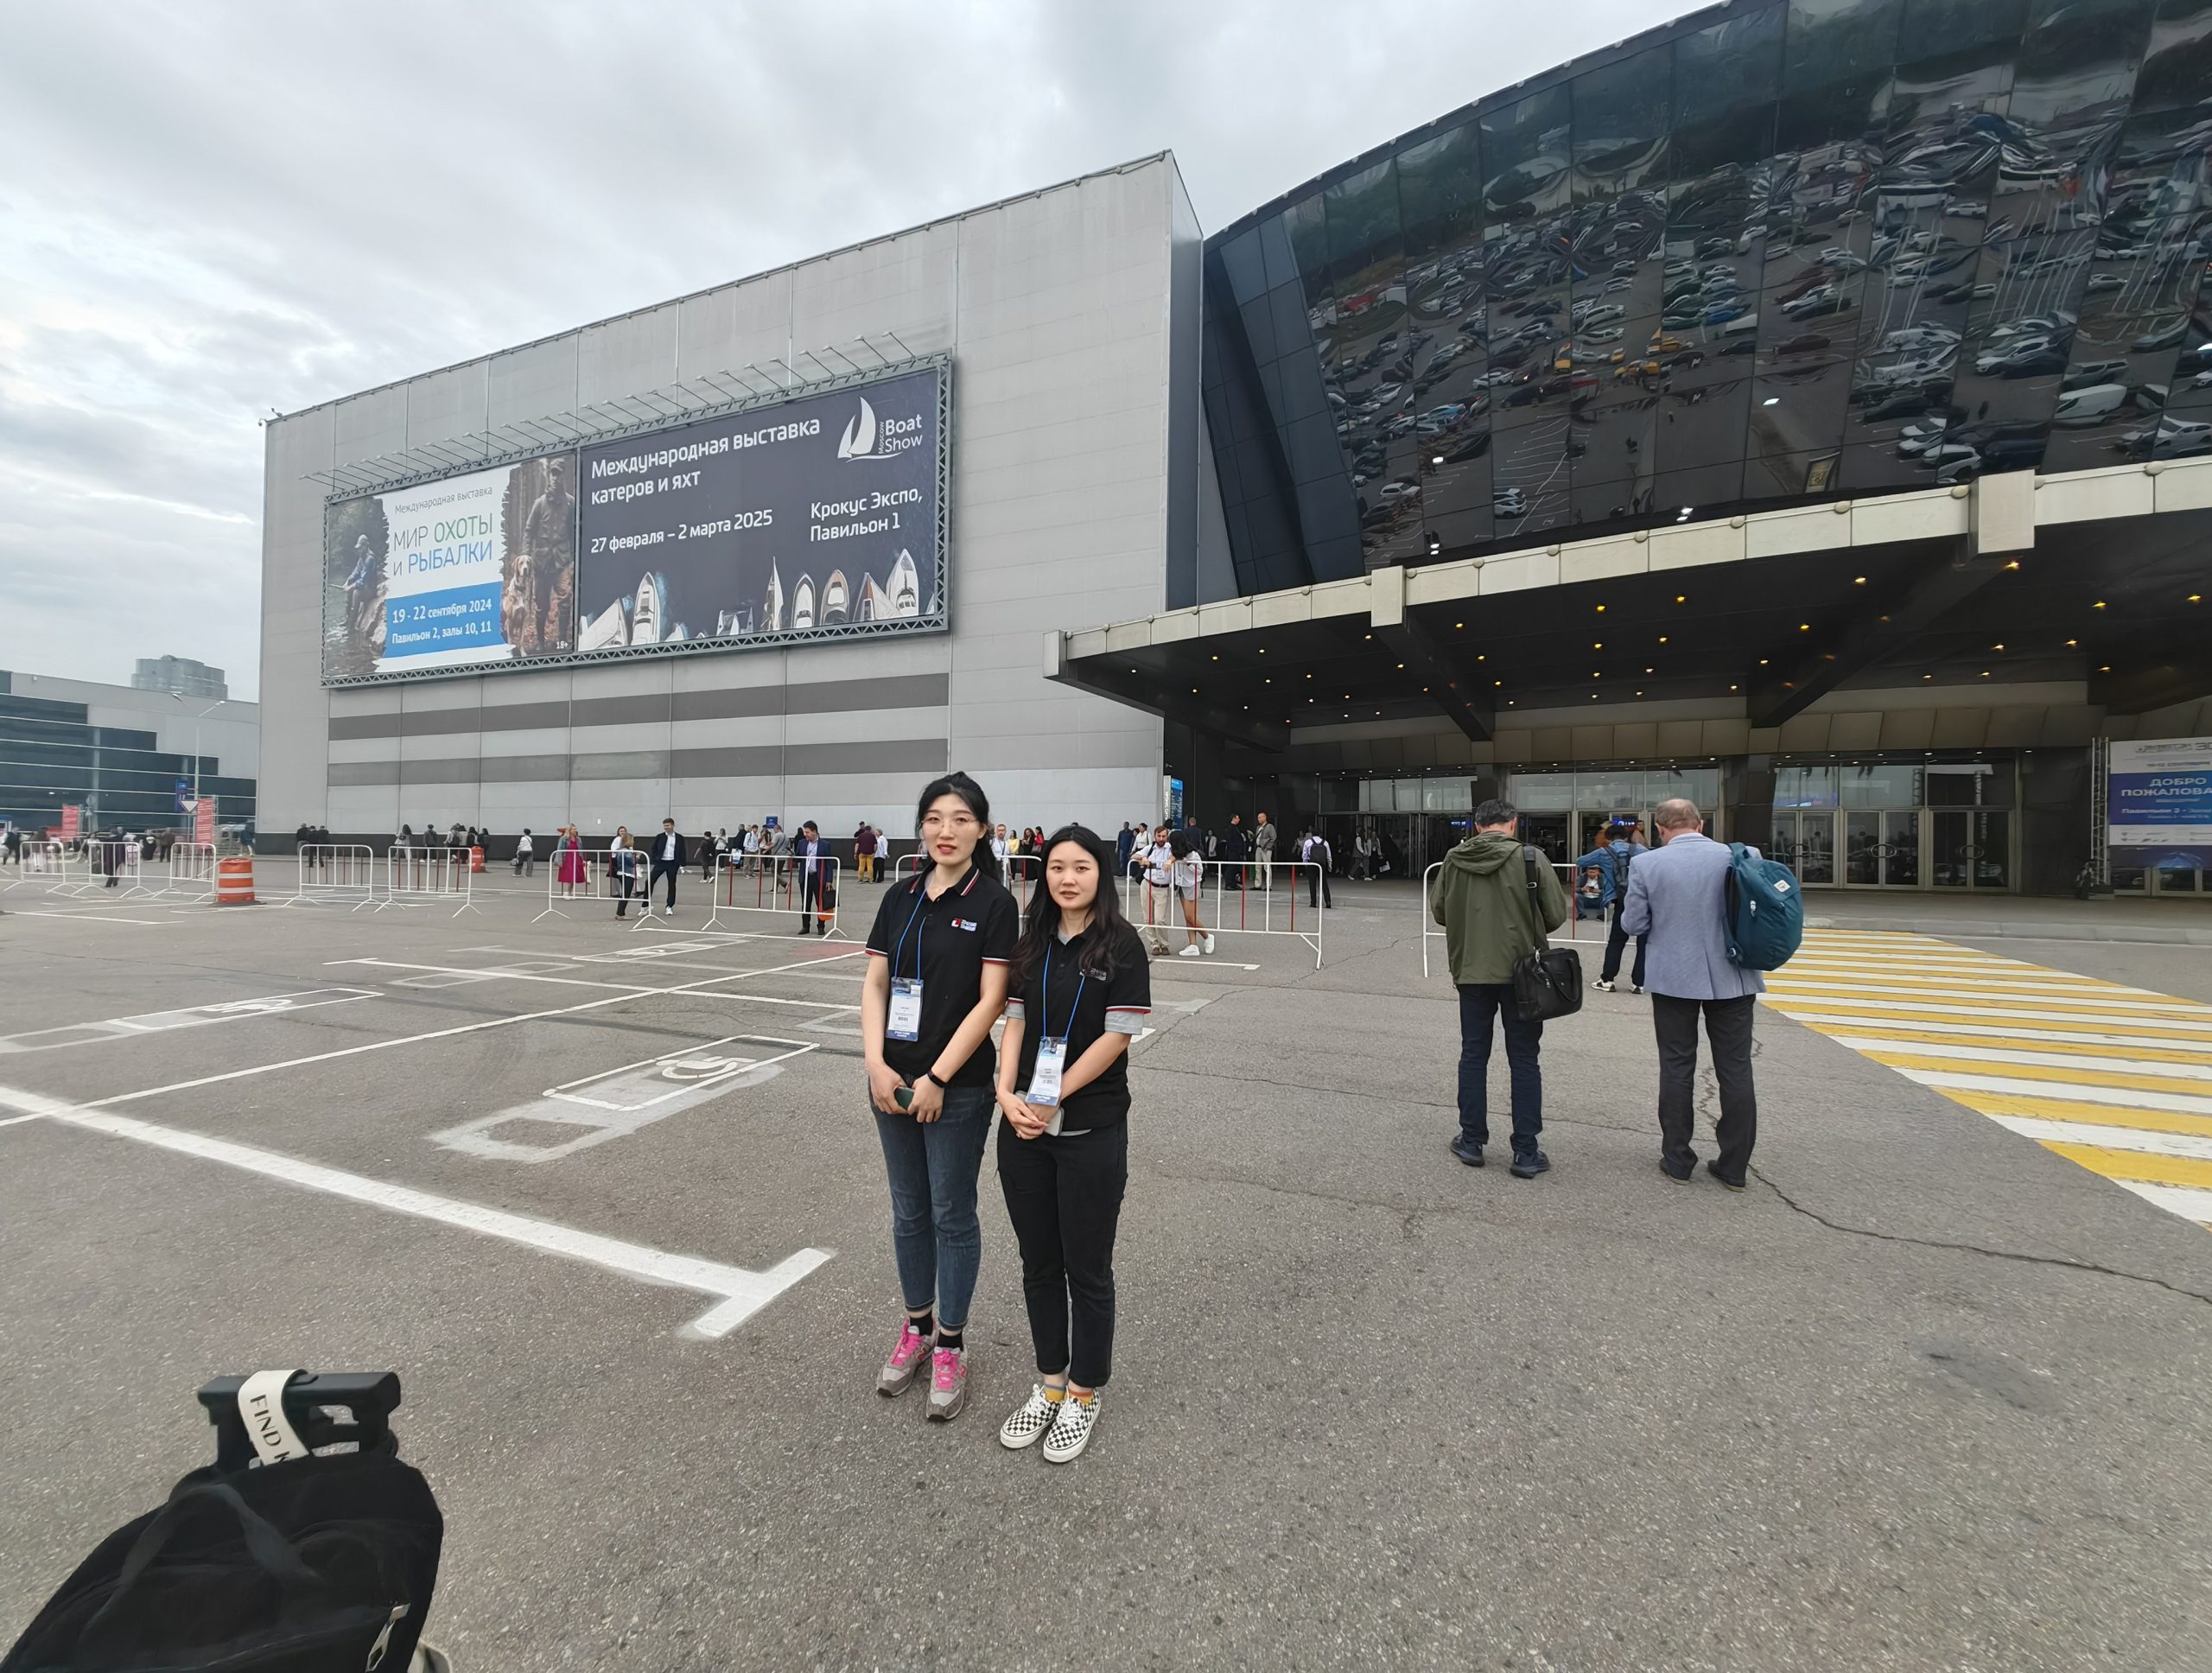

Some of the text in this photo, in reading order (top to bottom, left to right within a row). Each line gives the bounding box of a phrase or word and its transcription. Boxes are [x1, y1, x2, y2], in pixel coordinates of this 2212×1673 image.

[885, 413, 922, 436] Boat
[591, 418, 820, 479] Международная выставка
[885, 435, 923, 452] Show
[395, 487, 493, 515] Международная выставка
[591, 471, 701, 505] катеров и яхт
[810, 487, 923, 522] Крокус Экспо,
[394, 512, 493, 551] МИР ОХОТЫ
[591, 537, 607, 554] 27
[608, 530, 664, 553] февраля
[677, 524, 687, 540] 2
[690, 518, 731, 538] марта
[734, 509, 773, 530] 2025
[810, 512, 900, 543] Павильон 1
[408, 539, 493, 574] РЫБАЛКИ
[392, 608, 405, 624] 19
[413, 605, 426, 620] 22
[428, 603, 467, 618] сентября
[469, 598, 493, 613] 2024
[391, 620, 492, 644] Павильон 2, залы 10, 11
[2149, 777, 2207, 787] ДОБРО
[250, 1393, 283, 1447] FIND
